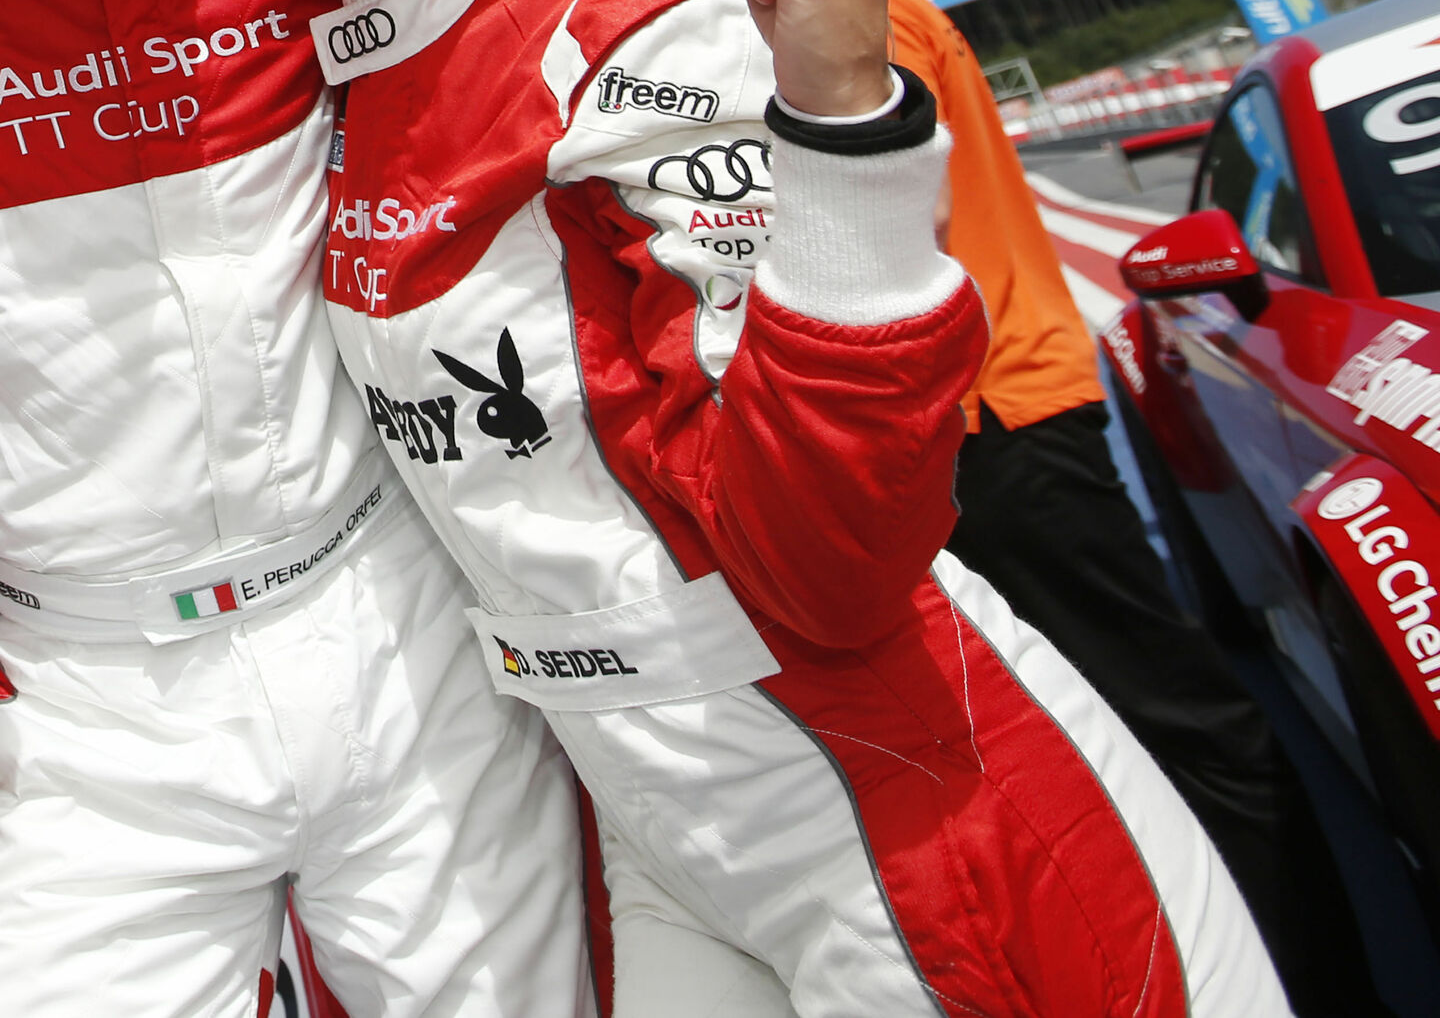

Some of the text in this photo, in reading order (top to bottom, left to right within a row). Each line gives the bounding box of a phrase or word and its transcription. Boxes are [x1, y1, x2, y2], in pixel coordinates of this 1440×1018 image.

[143, 10, 290, 77] Sport
[602, 71, 716, 119] freem
[688, 208, 767, 234] Audi
[241, 484, 383, 601] E. PERUCCA ORFEI
[1343, 504, 1410, 566] LG
[511, 647, 639, 679] D. SEIDEL
